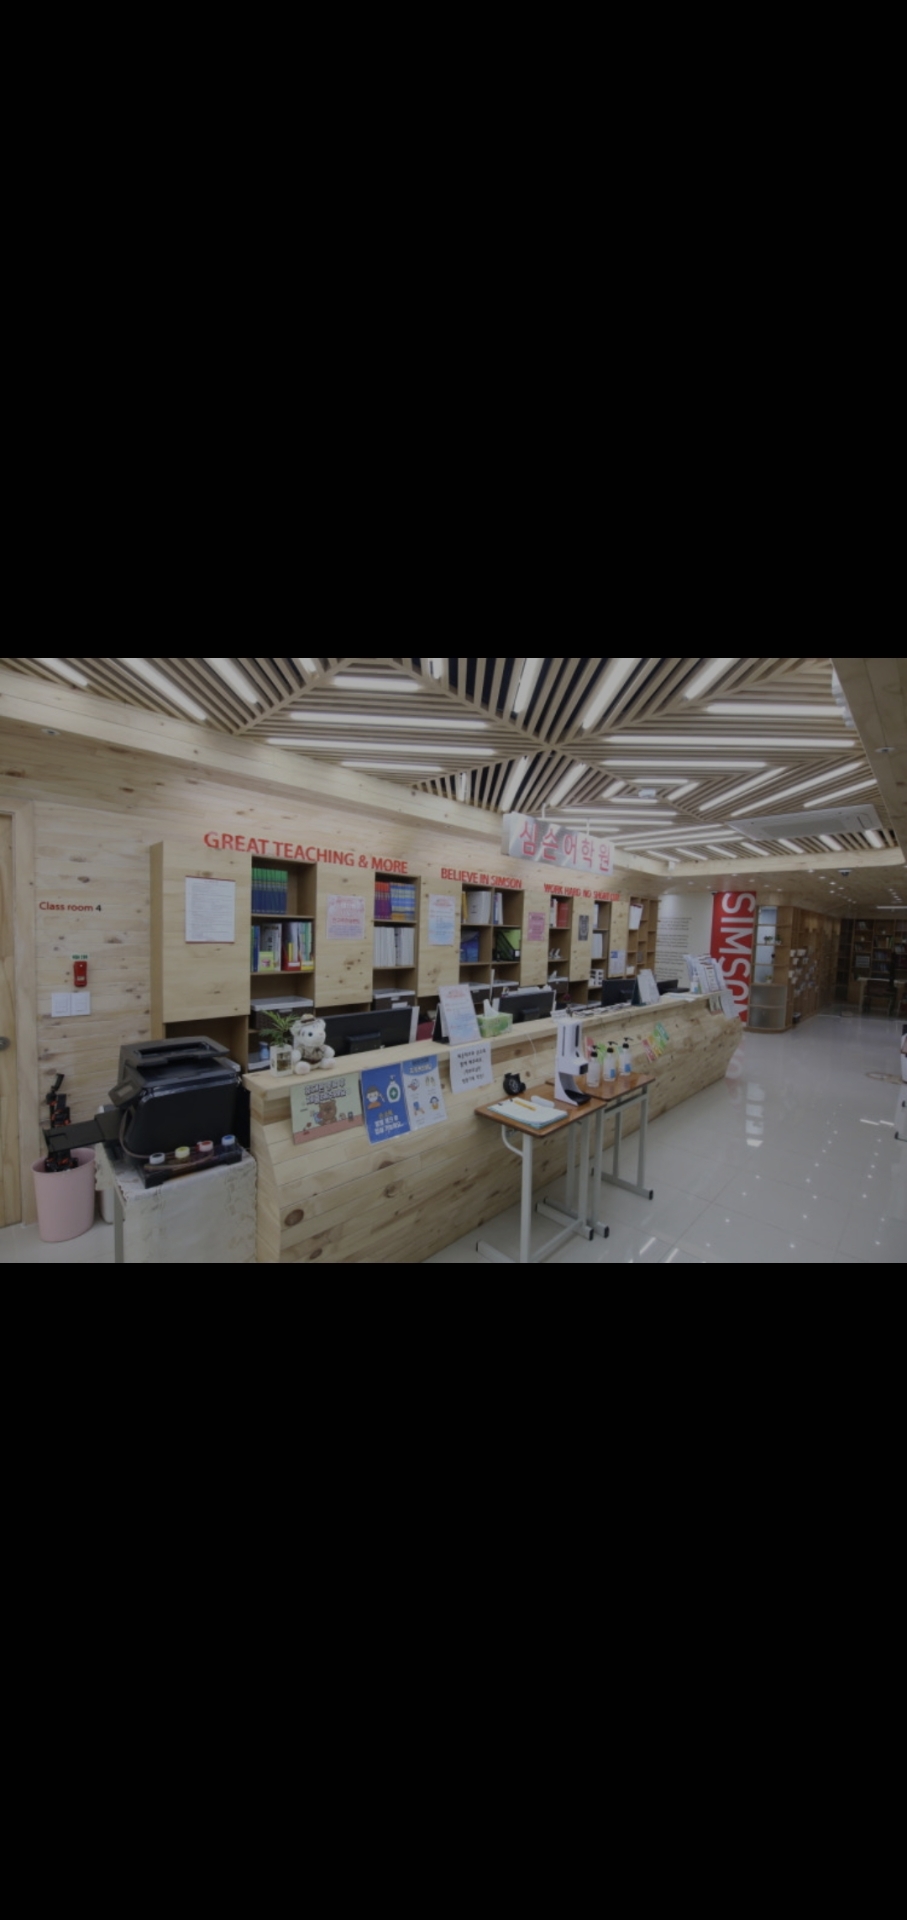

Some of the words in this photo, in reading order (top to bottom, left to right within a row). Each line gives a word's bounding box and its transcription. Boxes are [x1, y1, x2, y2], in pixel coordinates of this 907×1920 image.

[203, 831, 269, 854] GREAT
[272, 841, 354, 866] TEACHING
[358, 854, 368, 868] &
[371, 856, 408, 873] MORE
[519, 821, 611, 872] 심손어학원
[441, 867, 478, 883] BELIEVE
[479, 873, 489, 885] IN
[490, 875, 522, 889] SIMSON
[544, 882, 563, 894] WORK
[564, 886, 581, 896] HARD
[582, 889, 592, 898] NO
[39, 901, 65, 911] Class
[67, 904, 93, 912] room
[95, 904, 102, 912] 4
